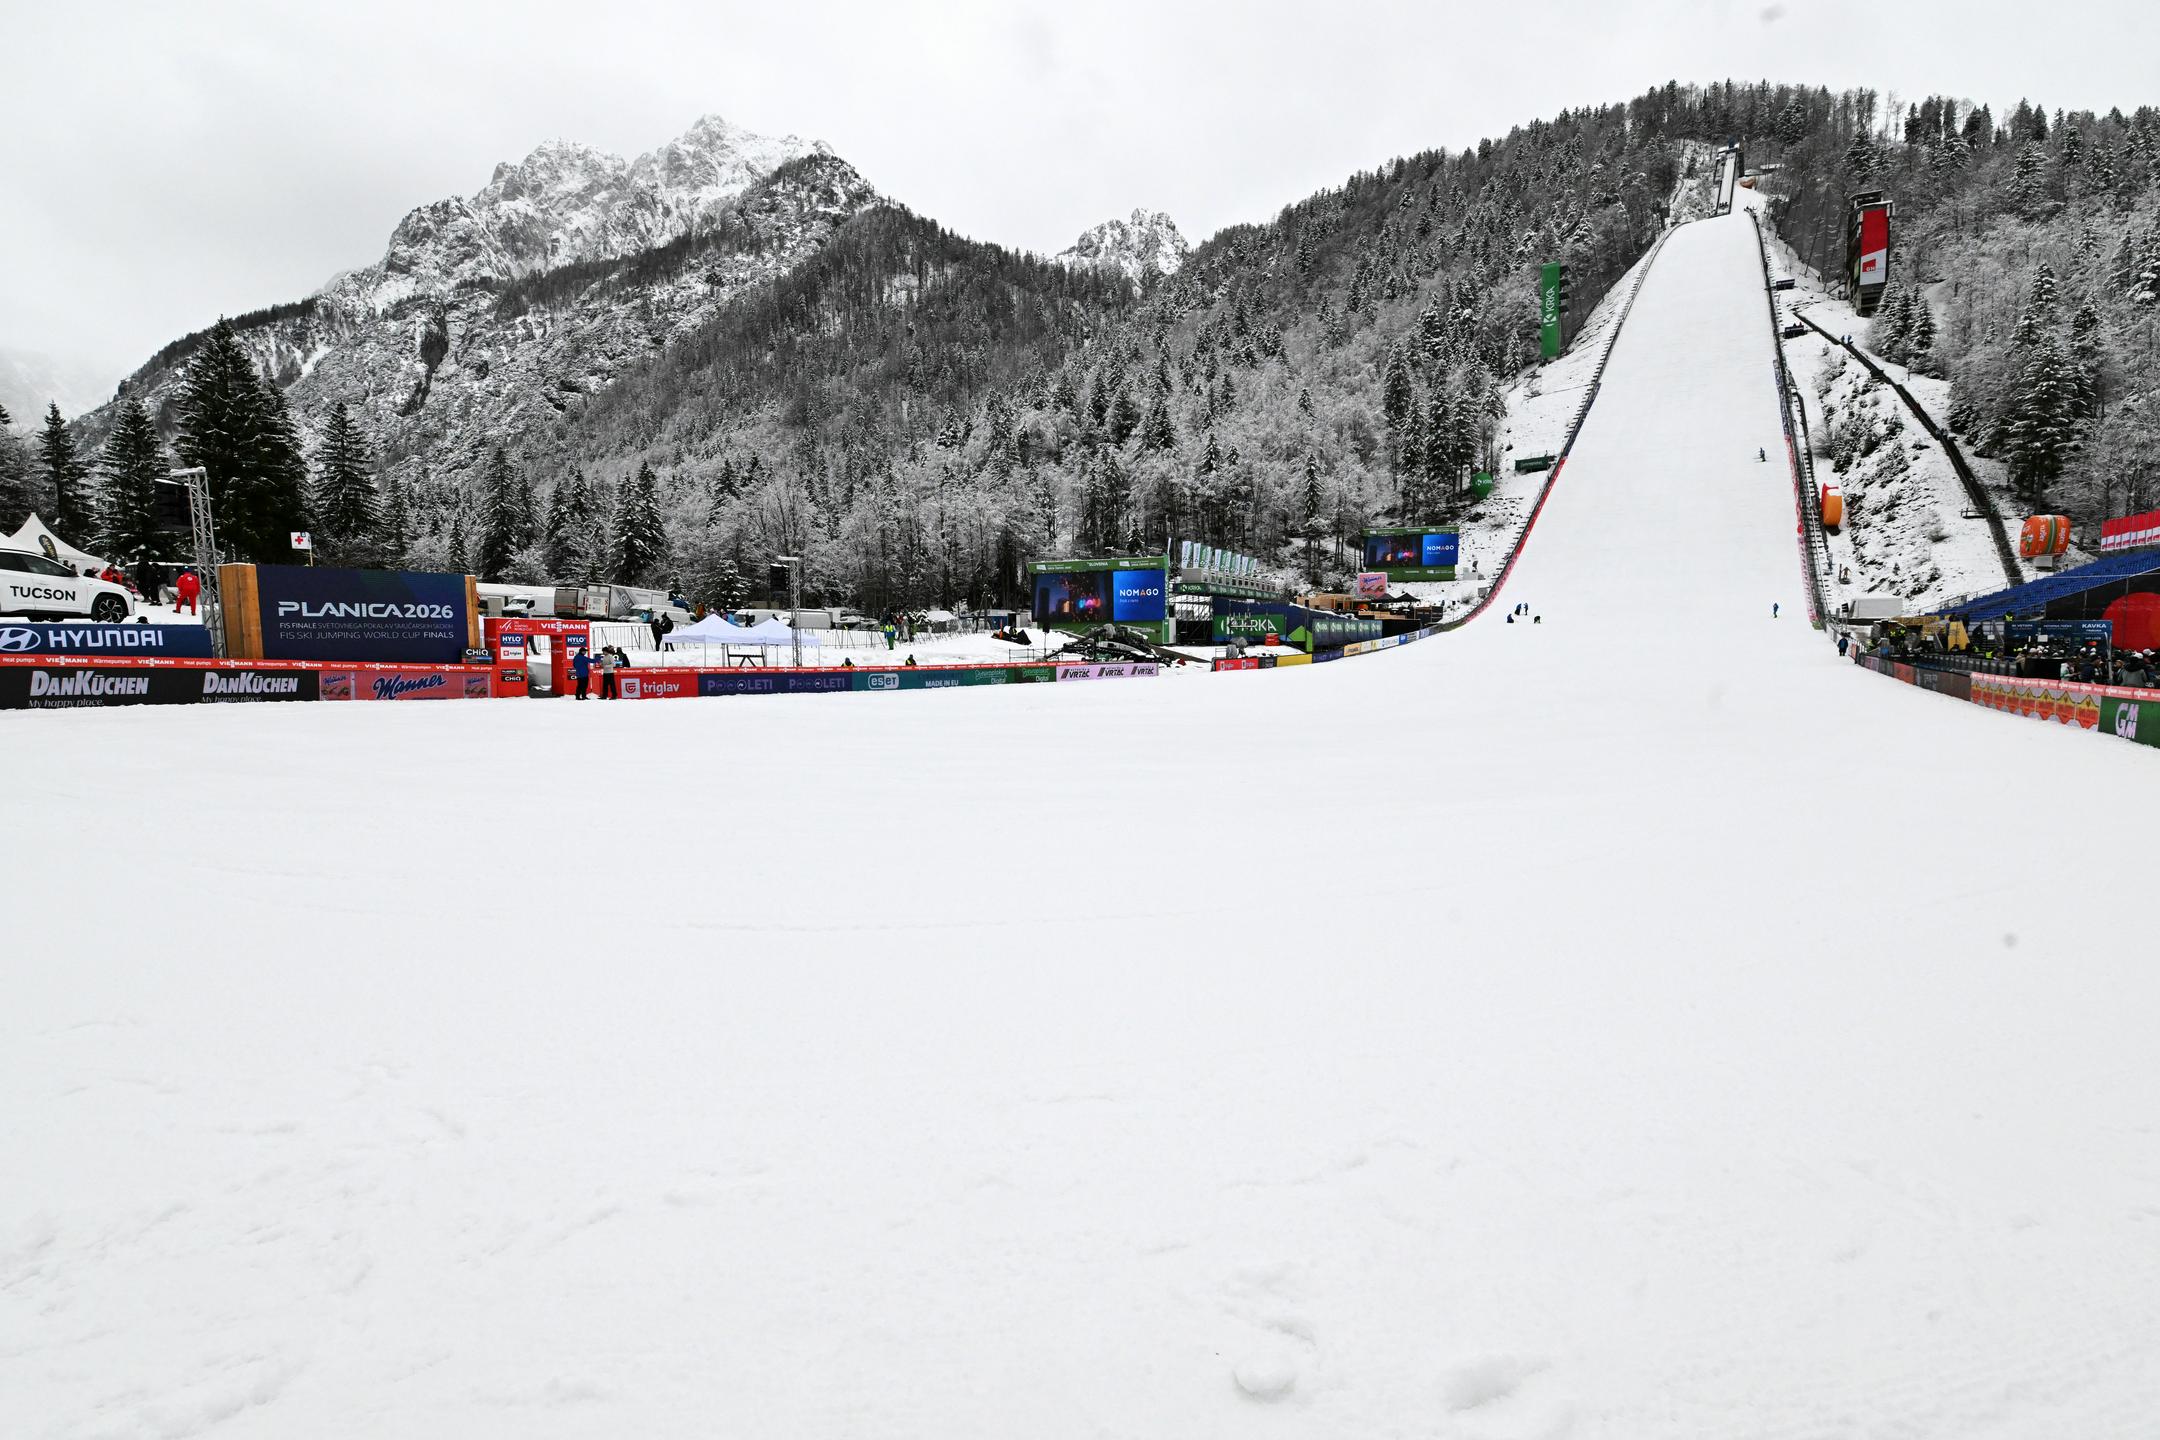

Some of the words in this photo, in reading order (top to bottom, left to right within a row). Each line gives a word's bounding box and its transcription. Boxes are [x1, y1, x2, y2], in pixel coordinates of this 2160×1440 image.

[1545, 285, 1555, 312] KRKA
[10, 585, 76, 601] TUCSON
[1120, 588, 1159, 597] NOMAGO
[278, 601, 403, 617] PLANICA
[403, 604, 454, 619] 2026
[48, 630, 164, 648] HYUNDAI
[280, 631, 295, 639] FIS
[296, 631, 313, 639] SKI
[316, 631, 361, 639] JUMPING
[363, 631, 400, 639] WORLD
[402, 631, 421, 639] CUP
[423, 631, 454, 639] FINALS
[373, 673, 447, 700] Manner
[642, 681, 680, 696] triglav
[925, 680, 943, 688] MADE
